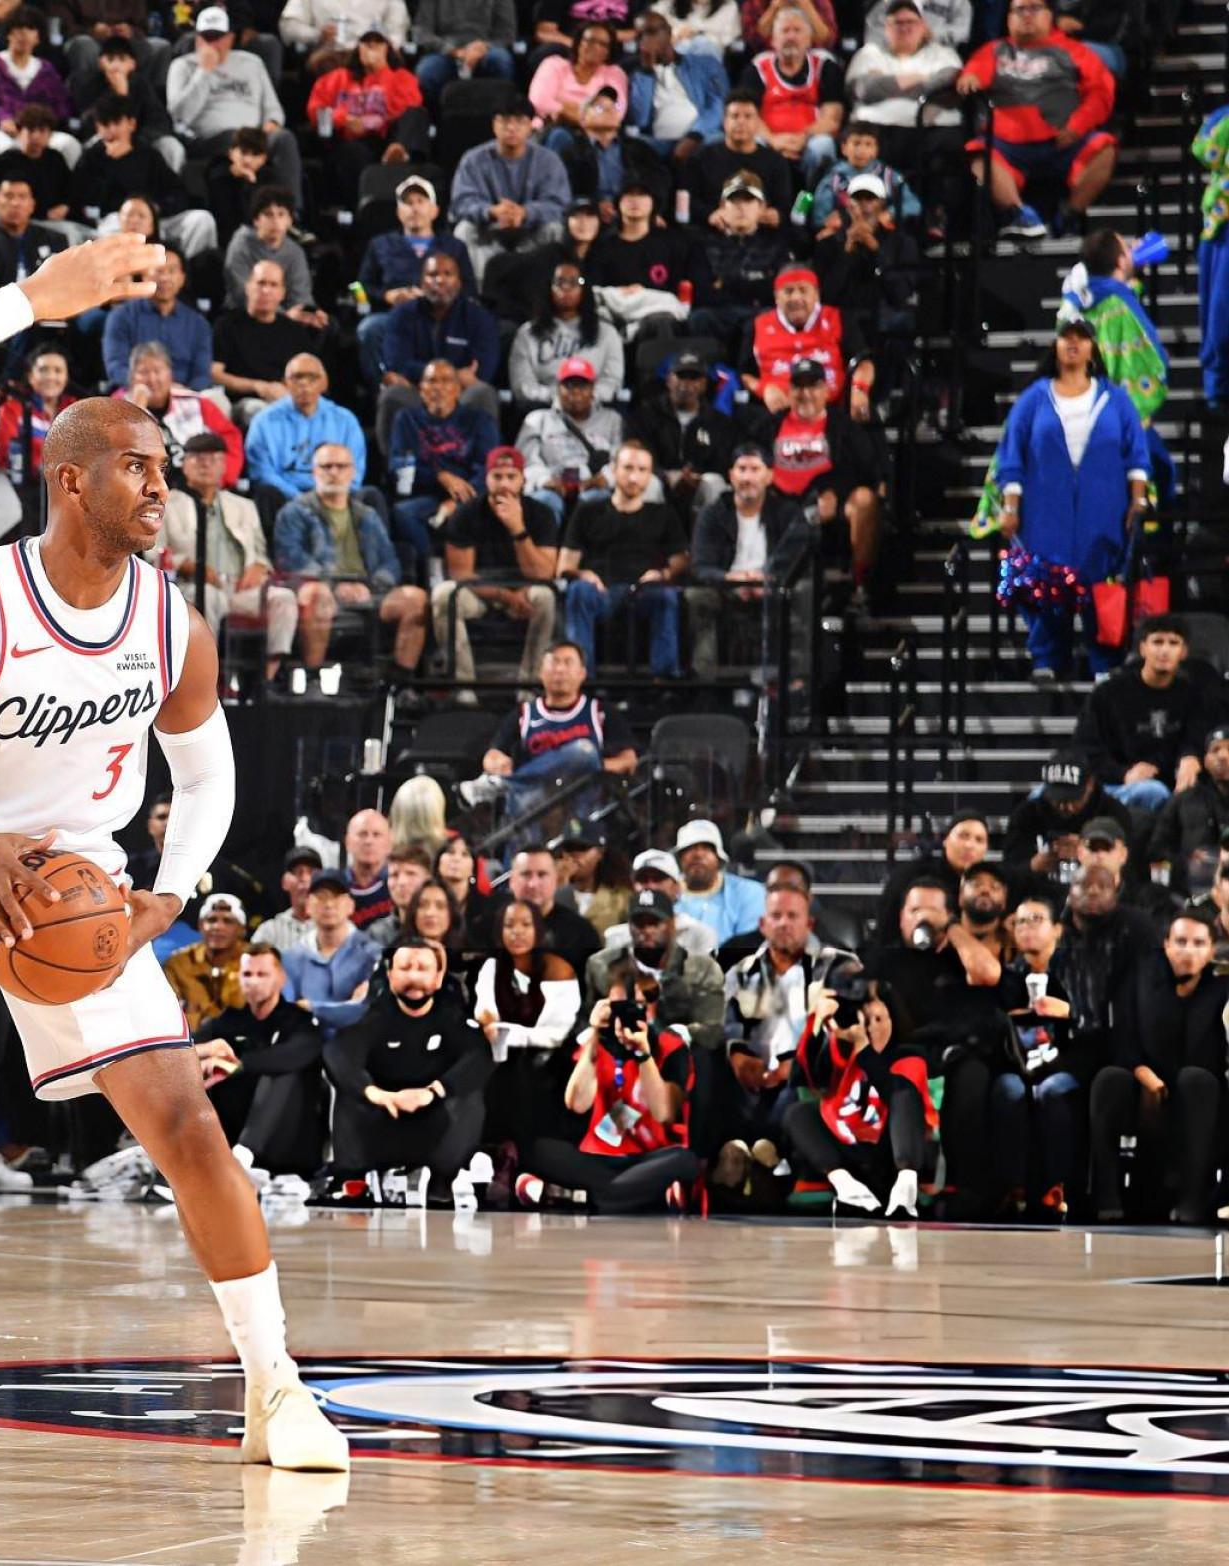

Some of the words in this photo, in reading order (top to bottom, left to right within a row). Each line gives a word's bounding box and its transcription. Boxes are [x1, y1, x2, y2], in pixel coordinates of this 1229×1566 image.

[124, 653, 147, 661] VISIT
[116, 662, 156, 670] RWANDA
[92, 742, 135, 800] 3
